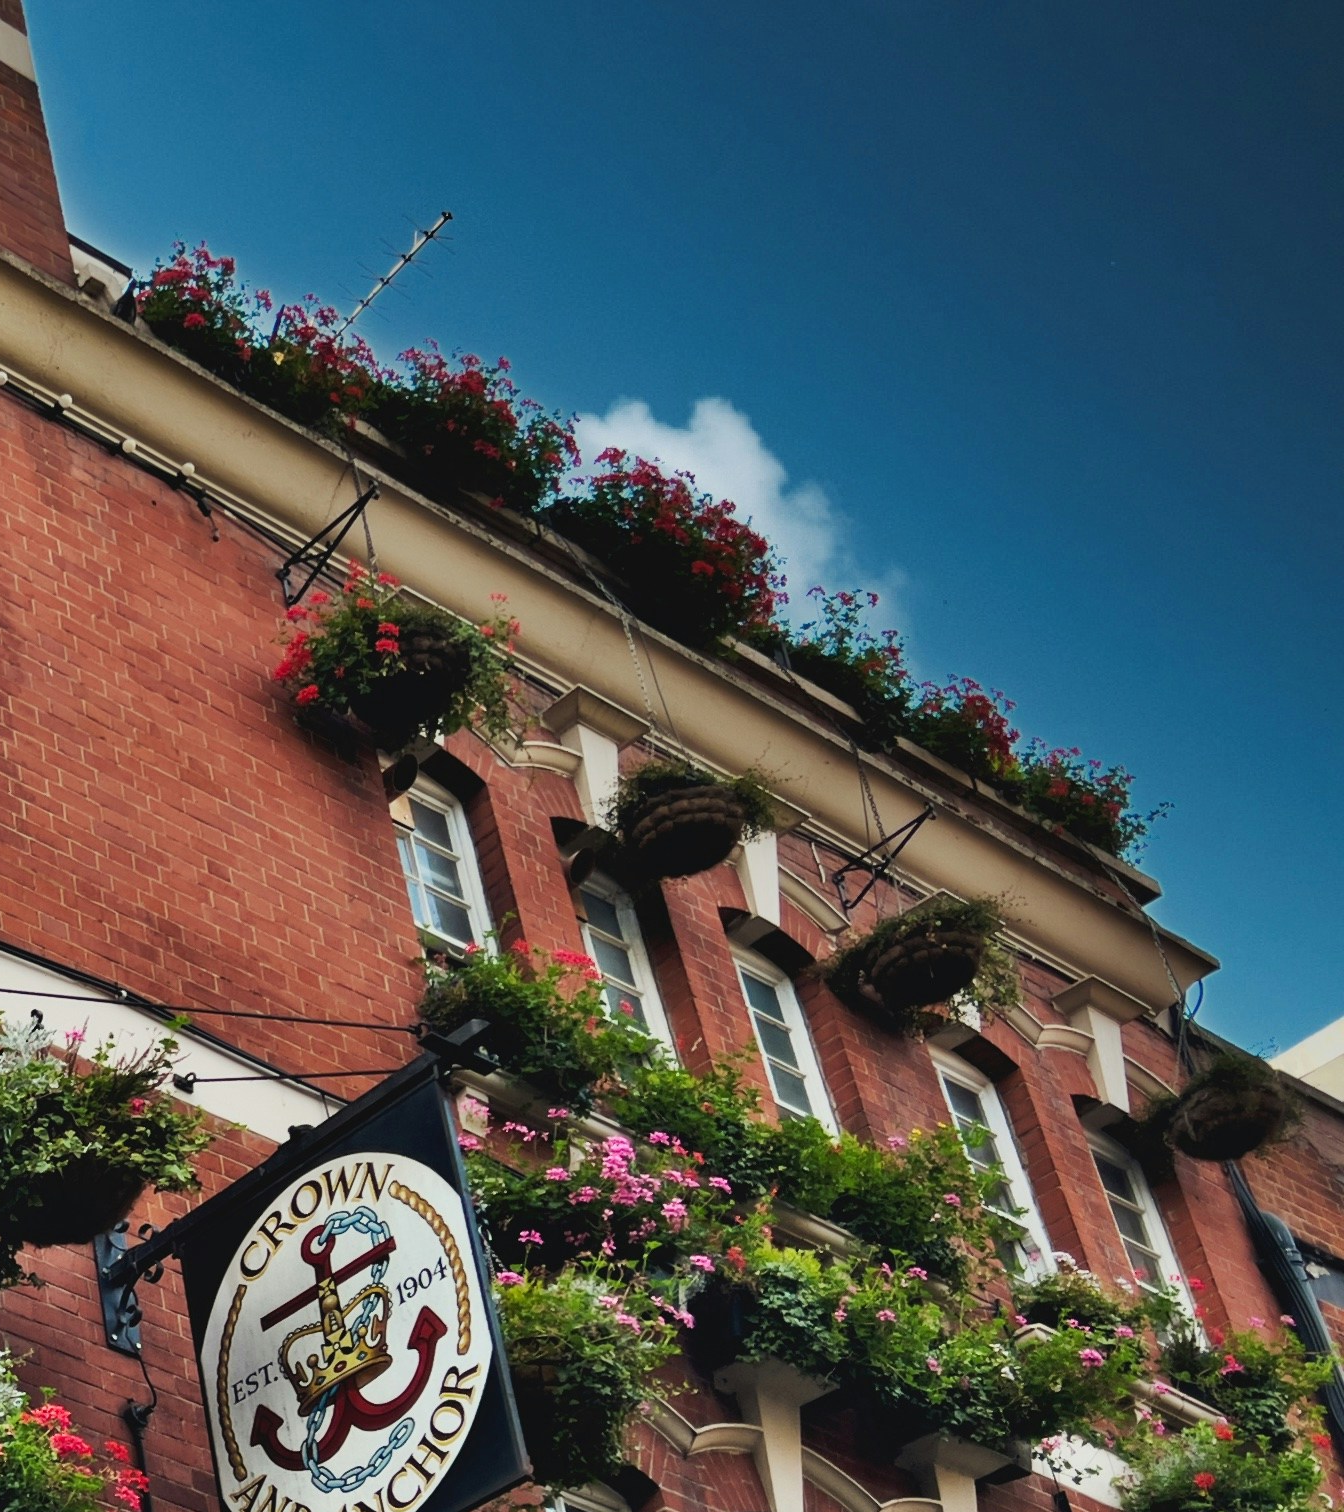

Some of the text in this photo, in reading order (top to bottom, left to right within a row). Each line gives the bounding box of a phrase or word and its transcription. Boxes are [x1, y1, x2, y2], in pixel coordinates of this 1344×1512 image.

[239, 1161, 396, 1282] CROWN
[231, 1257, 448, 1405] EST. 1904
